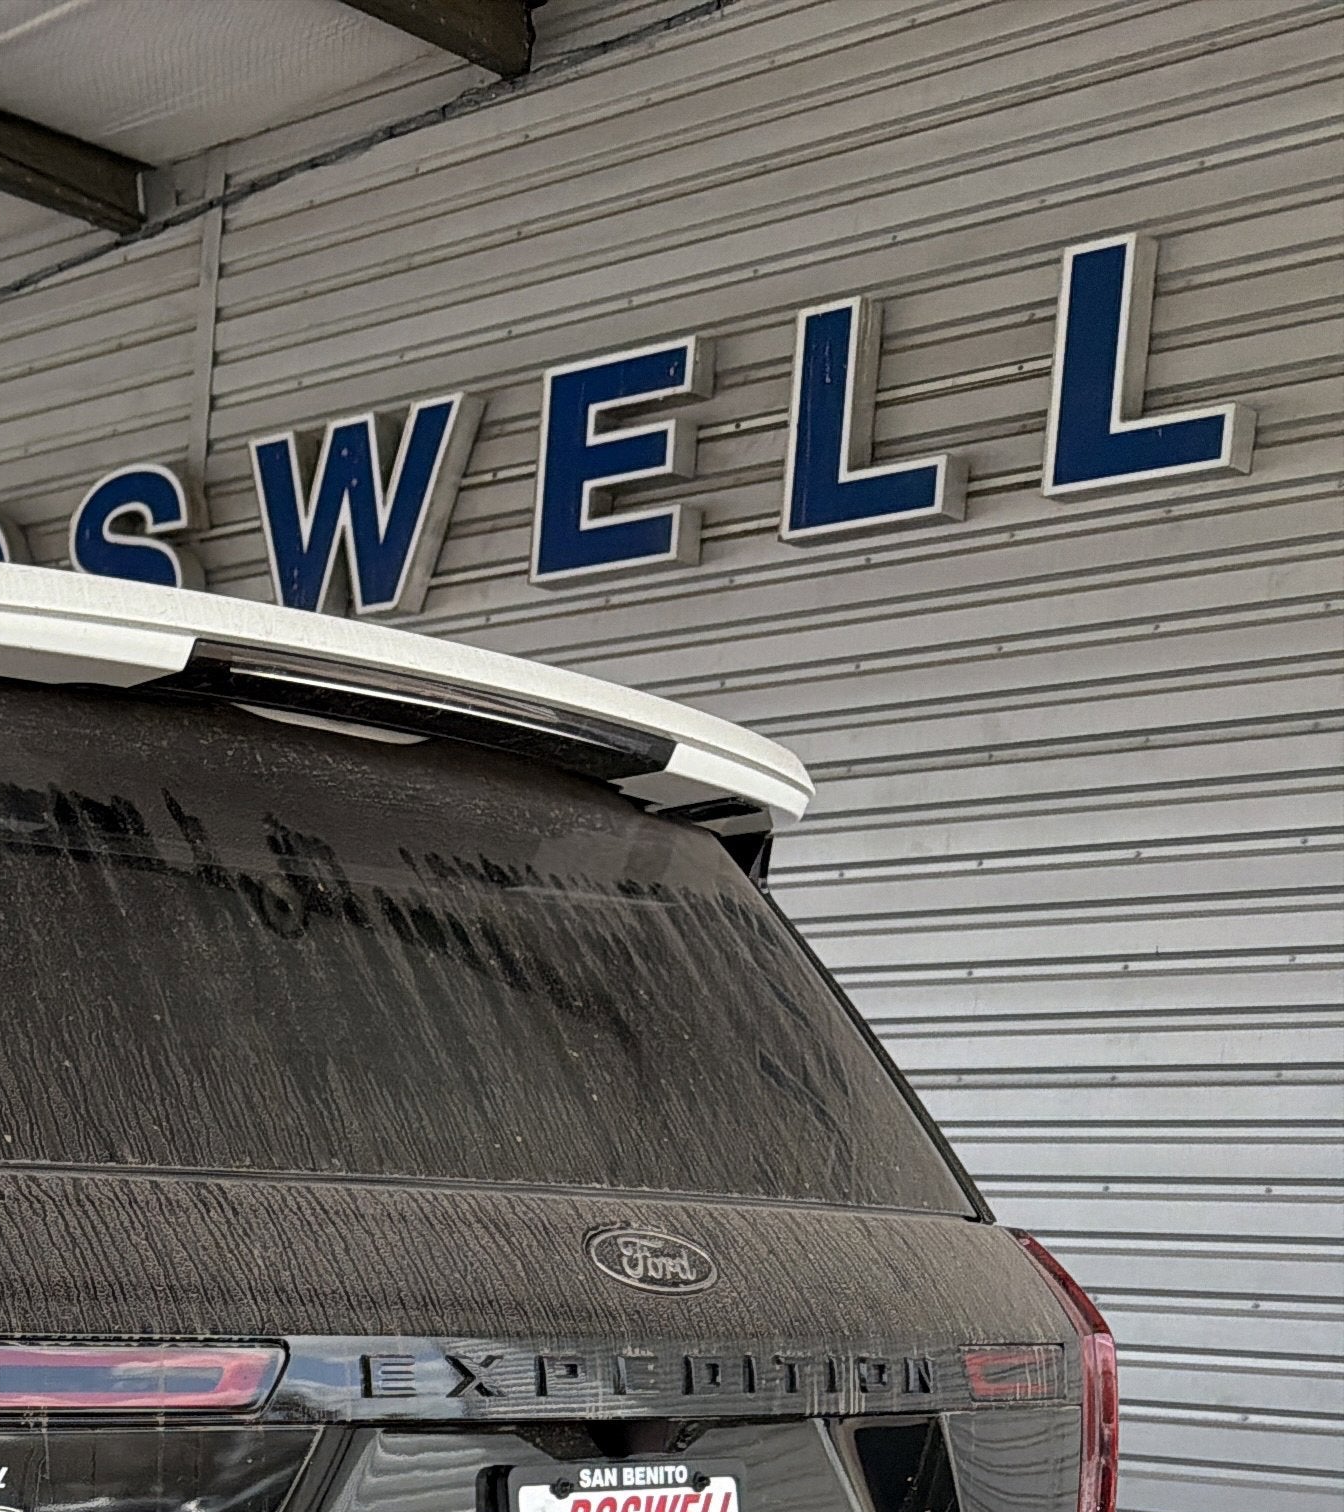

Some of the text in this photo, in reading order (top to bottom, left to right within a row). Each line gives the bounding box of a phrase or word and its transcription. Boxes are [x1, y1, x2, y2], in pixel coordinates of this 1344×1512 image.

[358, 1346, 937, 1400] EXPEDITION
[579, 1465, 688, 1488] SAN BENITO
